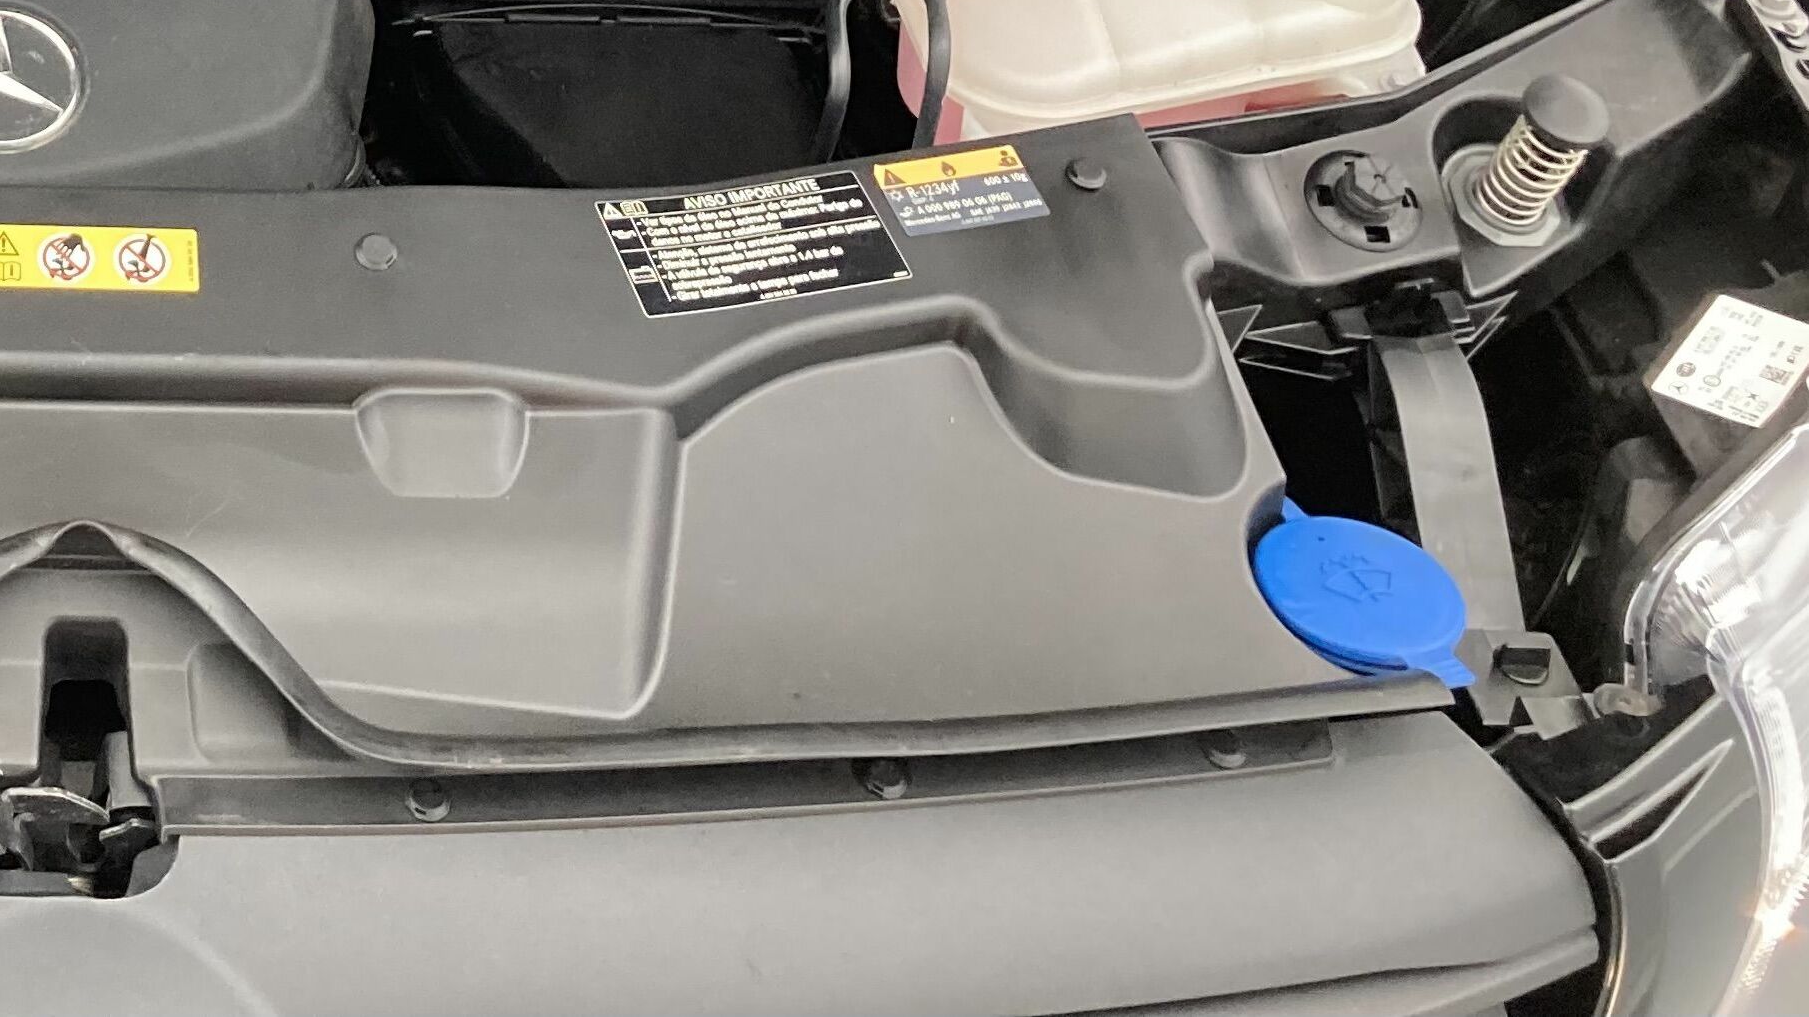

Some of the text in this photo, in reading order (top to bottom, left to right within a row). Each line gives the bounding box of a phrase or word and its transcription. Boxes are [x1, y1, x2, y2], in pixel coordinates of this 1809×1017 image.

[684, 178, 821, 209] AVISO IMPORTANTE
[905, 181, 960, 198] R-1234yf
[926, 203, 942, 212] 000
